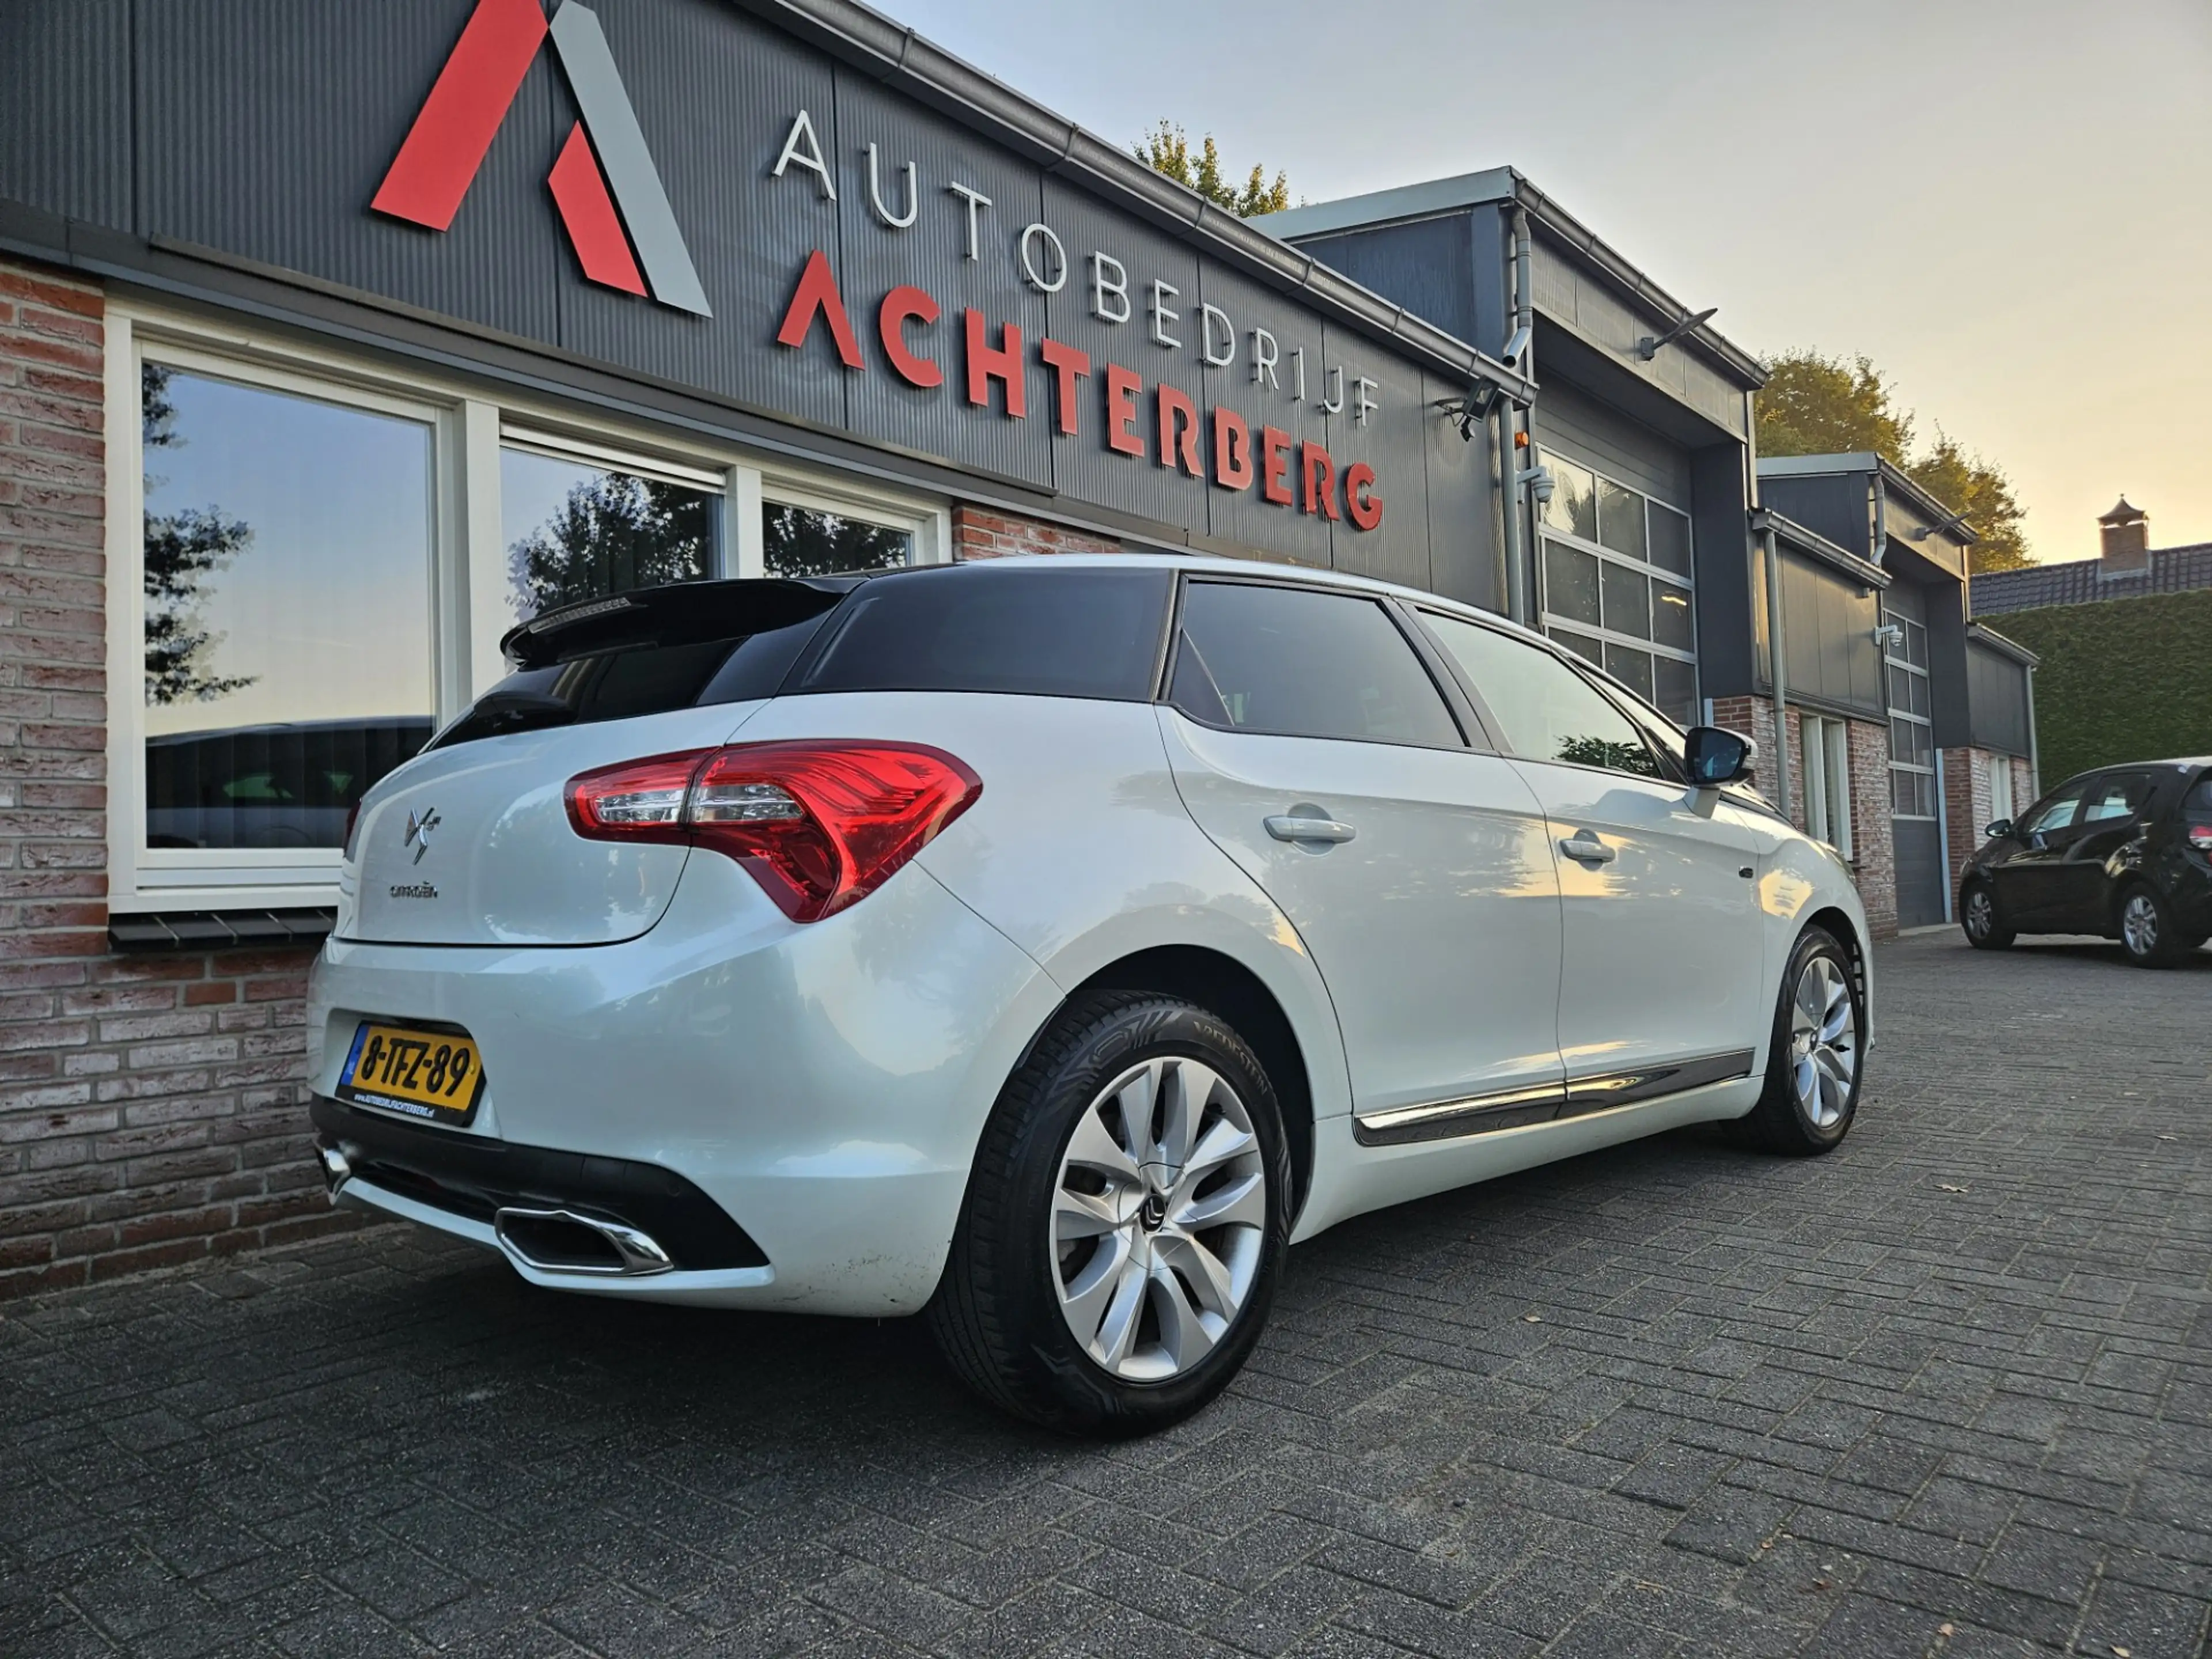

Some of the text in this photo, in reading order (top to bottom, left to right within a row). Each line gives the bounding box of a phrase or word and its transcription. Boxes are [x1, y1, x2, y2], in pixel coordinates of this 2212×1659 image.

[772, 109, 1380, 427] AUTOBEDRIJF
[777, 249, 1384, 531] ACHTERBERG
[361, 1035, 470, 1097] 8-TFZ-89
